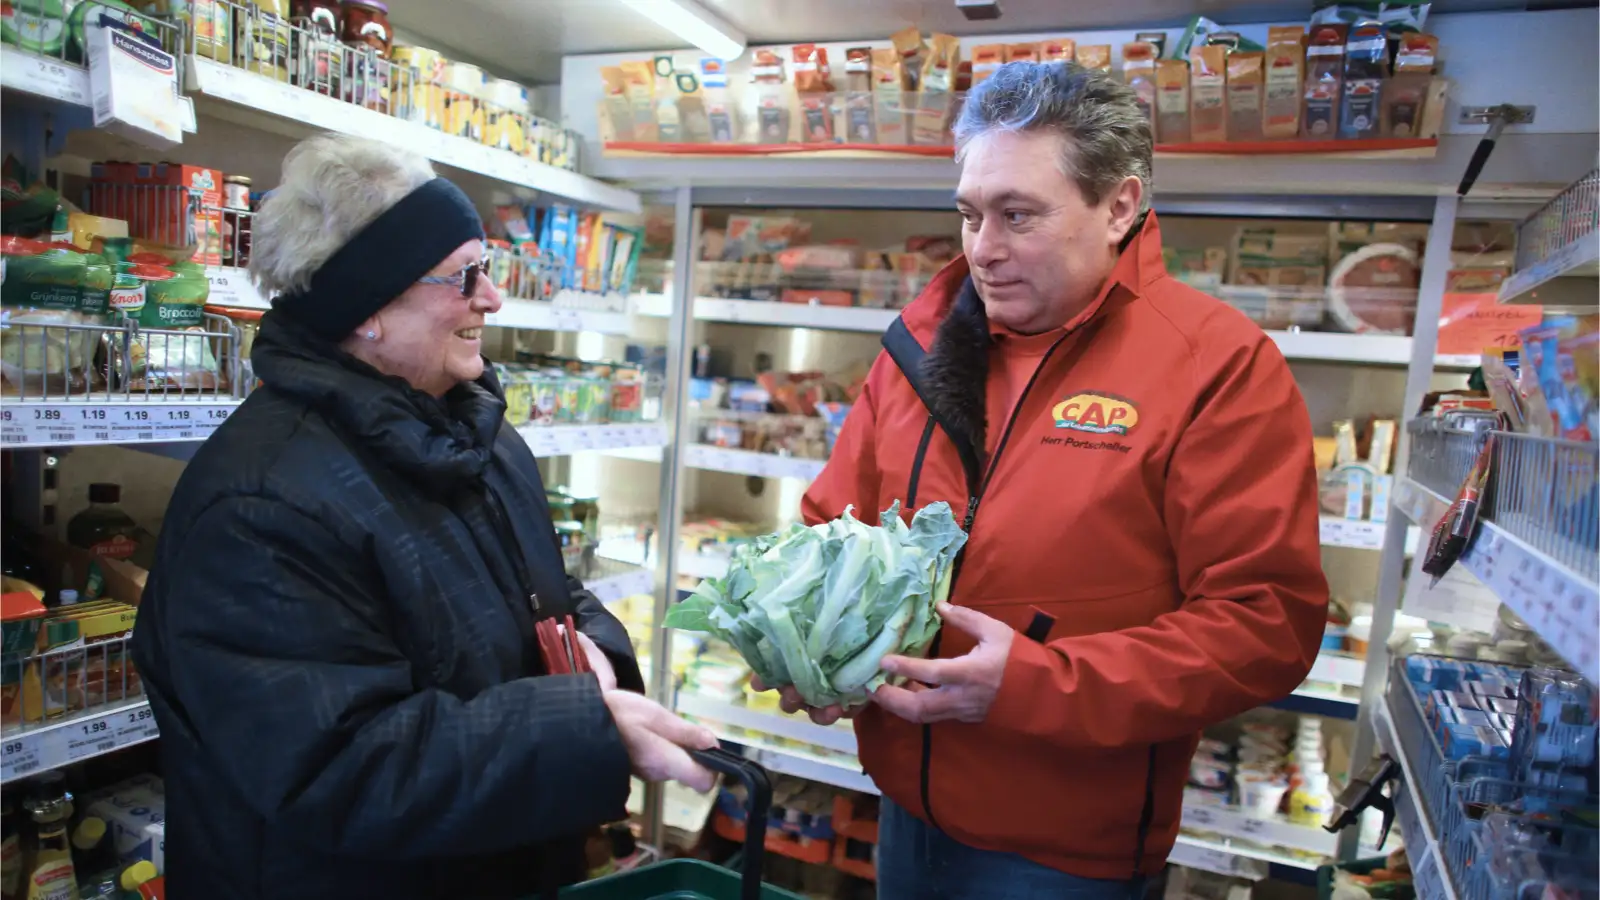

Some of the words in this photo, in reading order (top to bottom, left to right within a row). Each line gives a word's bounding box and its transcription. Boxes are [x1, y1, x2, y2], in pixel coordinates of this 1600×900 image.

[115, 36, 170, 67] Hansaplast
[81, 409, 106, 420] 1.19
[124, 410, 149, 421] 1.19
[167, 410, 190, 420] 1.19
[207, 409, 228, 419] 1.49
[1061, 401, 1127, 428] CAP
[1040, 436, 1062, 445] Herr
[128, 709, 152, 723] 2.99
[82, 721, 107, 735] 1.99
